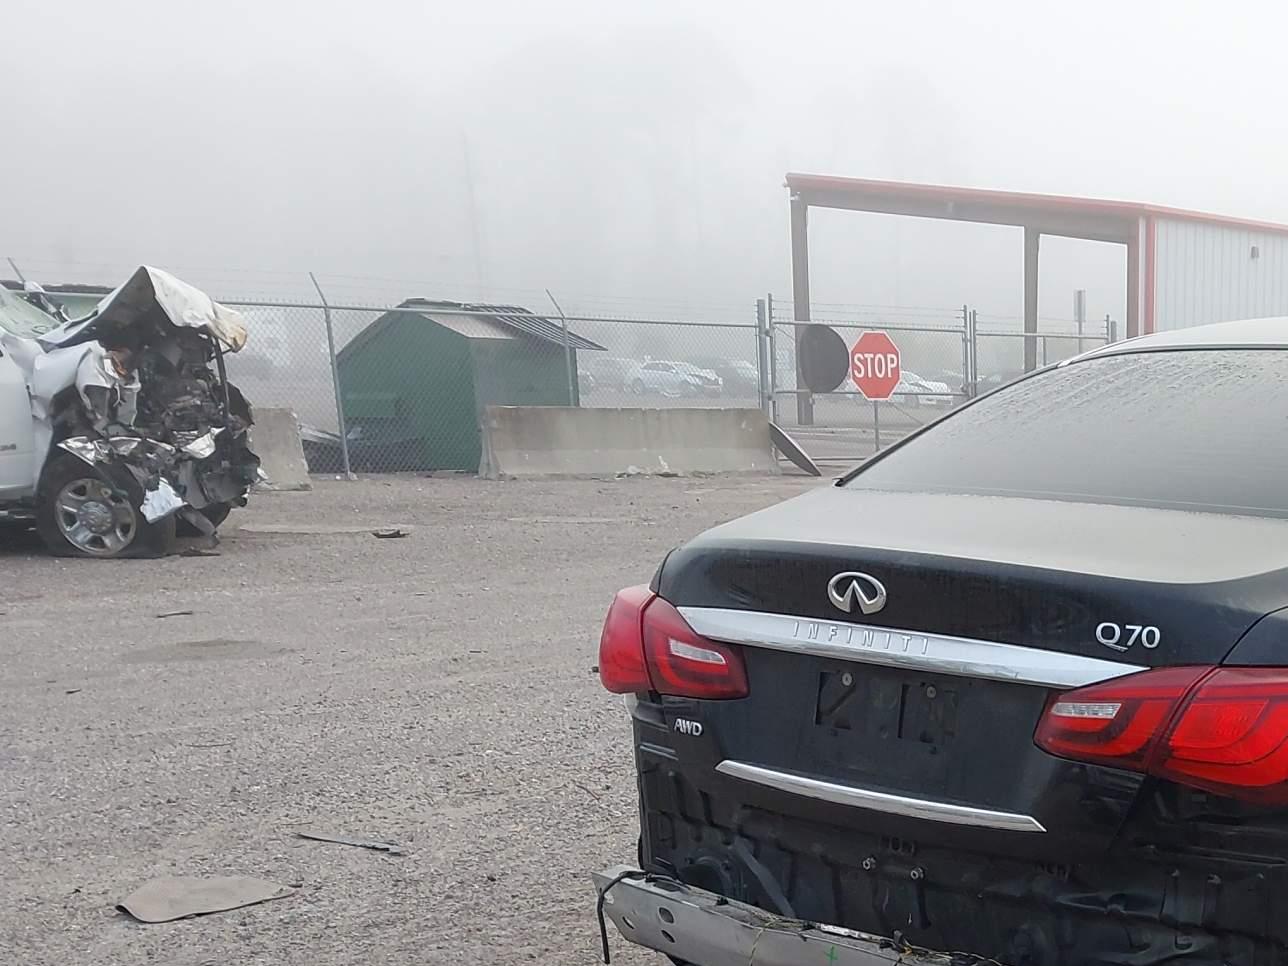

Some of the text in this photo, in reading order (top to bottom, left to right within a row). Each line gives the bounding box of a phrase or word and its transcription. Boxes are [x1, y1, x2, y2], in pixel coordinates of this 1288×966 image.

[853, 352, 898, 379] STOP
[792, 620, 930, 656] INFINITI
[1095, 621, 1161, 653] Q70
[673, 717, 703, 737] AWD
